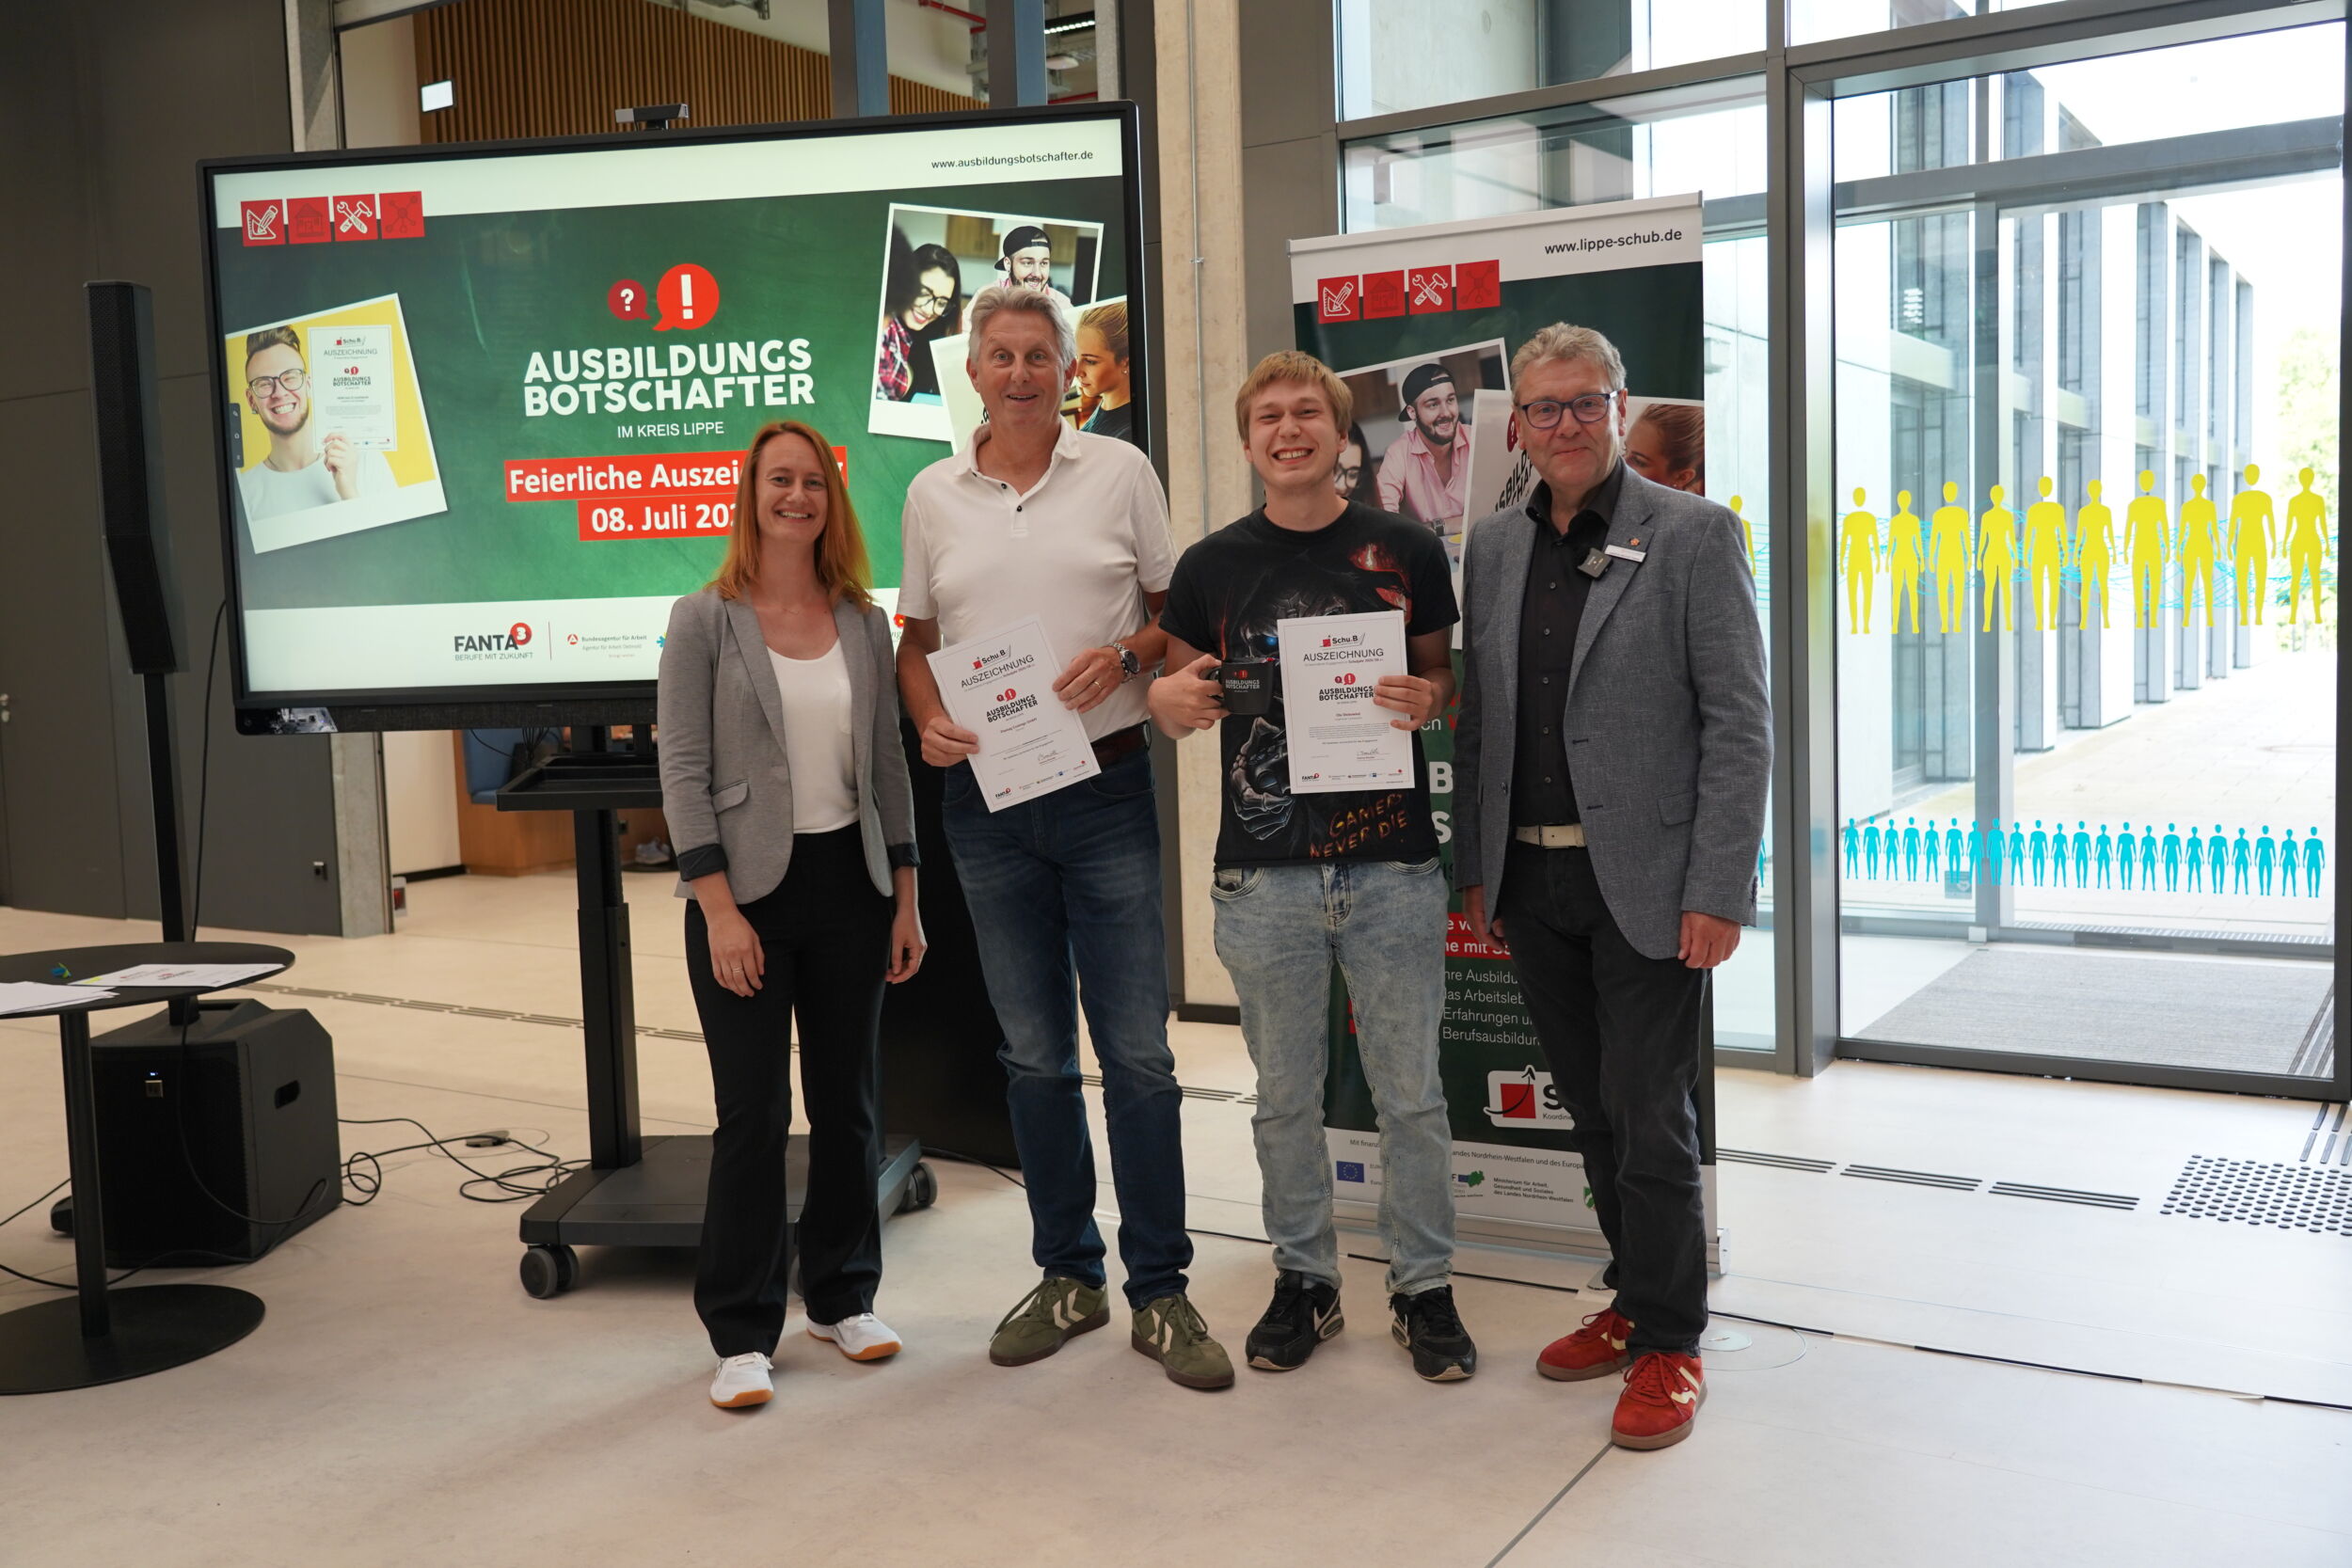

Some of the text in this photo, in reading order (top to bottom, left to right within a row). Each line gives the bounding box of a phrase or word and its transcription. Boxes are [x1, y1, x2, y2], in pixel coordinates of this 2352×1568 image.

[931, 150, 1093, 168] www.ausbildungsbotschafter.de
[1545, 229, 1682, 254] www.lippe-schub.de
[524, 339, 812, 383] AUSBILDUNGS
[524, 373, 815, 417] BOTSCHAFTER
[617, 421, 724, 438] IM KREIS LIPPE
[510, 459, 739, 494] Feierliche Auszei
[591, 508, 633, 533] 08.
[642, 504, 687, 531] Juli
[1332, 635, 1359, 644] Schu.B
[455, 653, 483, 661] BERUFE
[499, 652, 533, 660] ZUKUNFT
[982, 649, 1006, 664] Schu.B
[1303, 648, 1384, 661] AUSZEICHNUNG
[961, 654, 1035, 689] AUSZEICHNUNG
[1319, 686, 1374, 695] AUSBILDUNGS
[1319, 691, 1374, 702] BOTSCHAFTER
[986, 693, 1036, 718] AUSBILDUNGS
[987, 699, 1039, 723] BOTSCHAFTER
[1309, 809, 1408, 858] NEVER DIE
[1464, 942, 1487, 954] mit
[1443, 1007, 1518, 1027] Erfahrungen
[1471, 1151, 1534, 1164] Nordrhein-Westfalen
